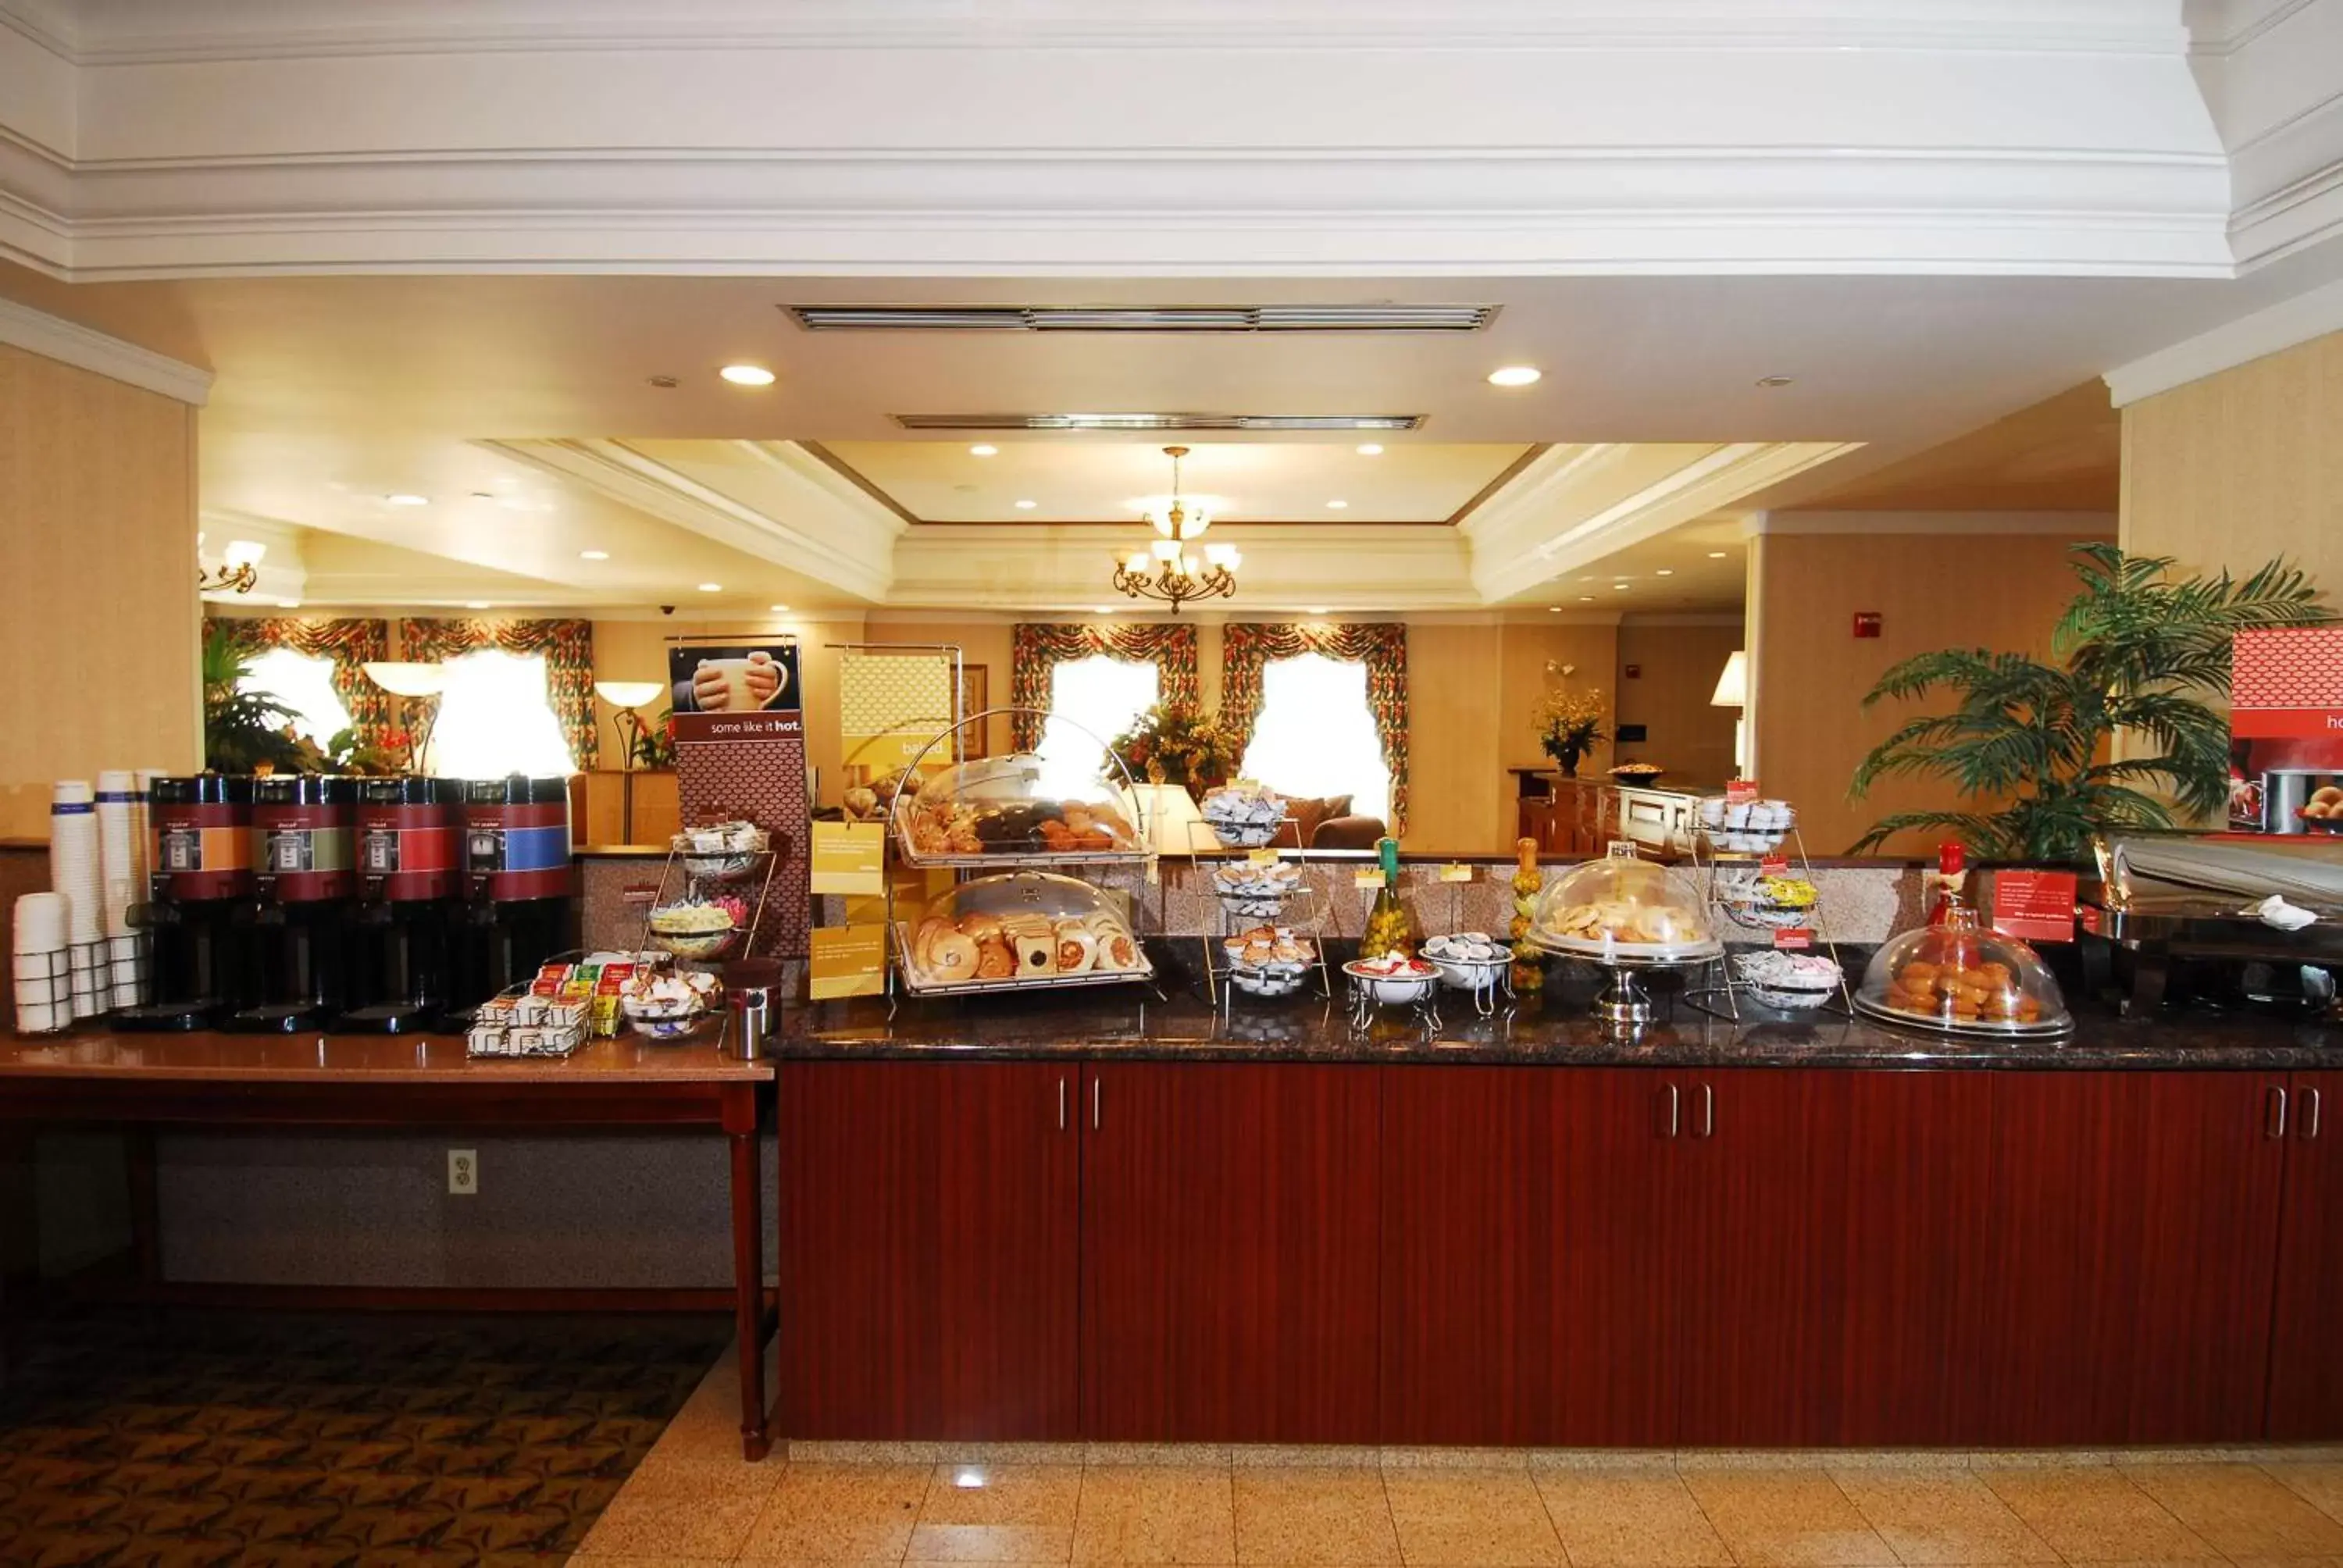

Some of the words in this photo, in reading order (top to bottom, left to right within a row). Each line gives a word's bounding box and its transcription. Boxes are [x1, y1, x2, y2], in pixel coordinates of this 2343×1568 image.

[711, 723, 741, 733] some
[743, 721, 763, 732] like
[765, 722, 773, 732] it
[775, 719, 802, 732] hot.
